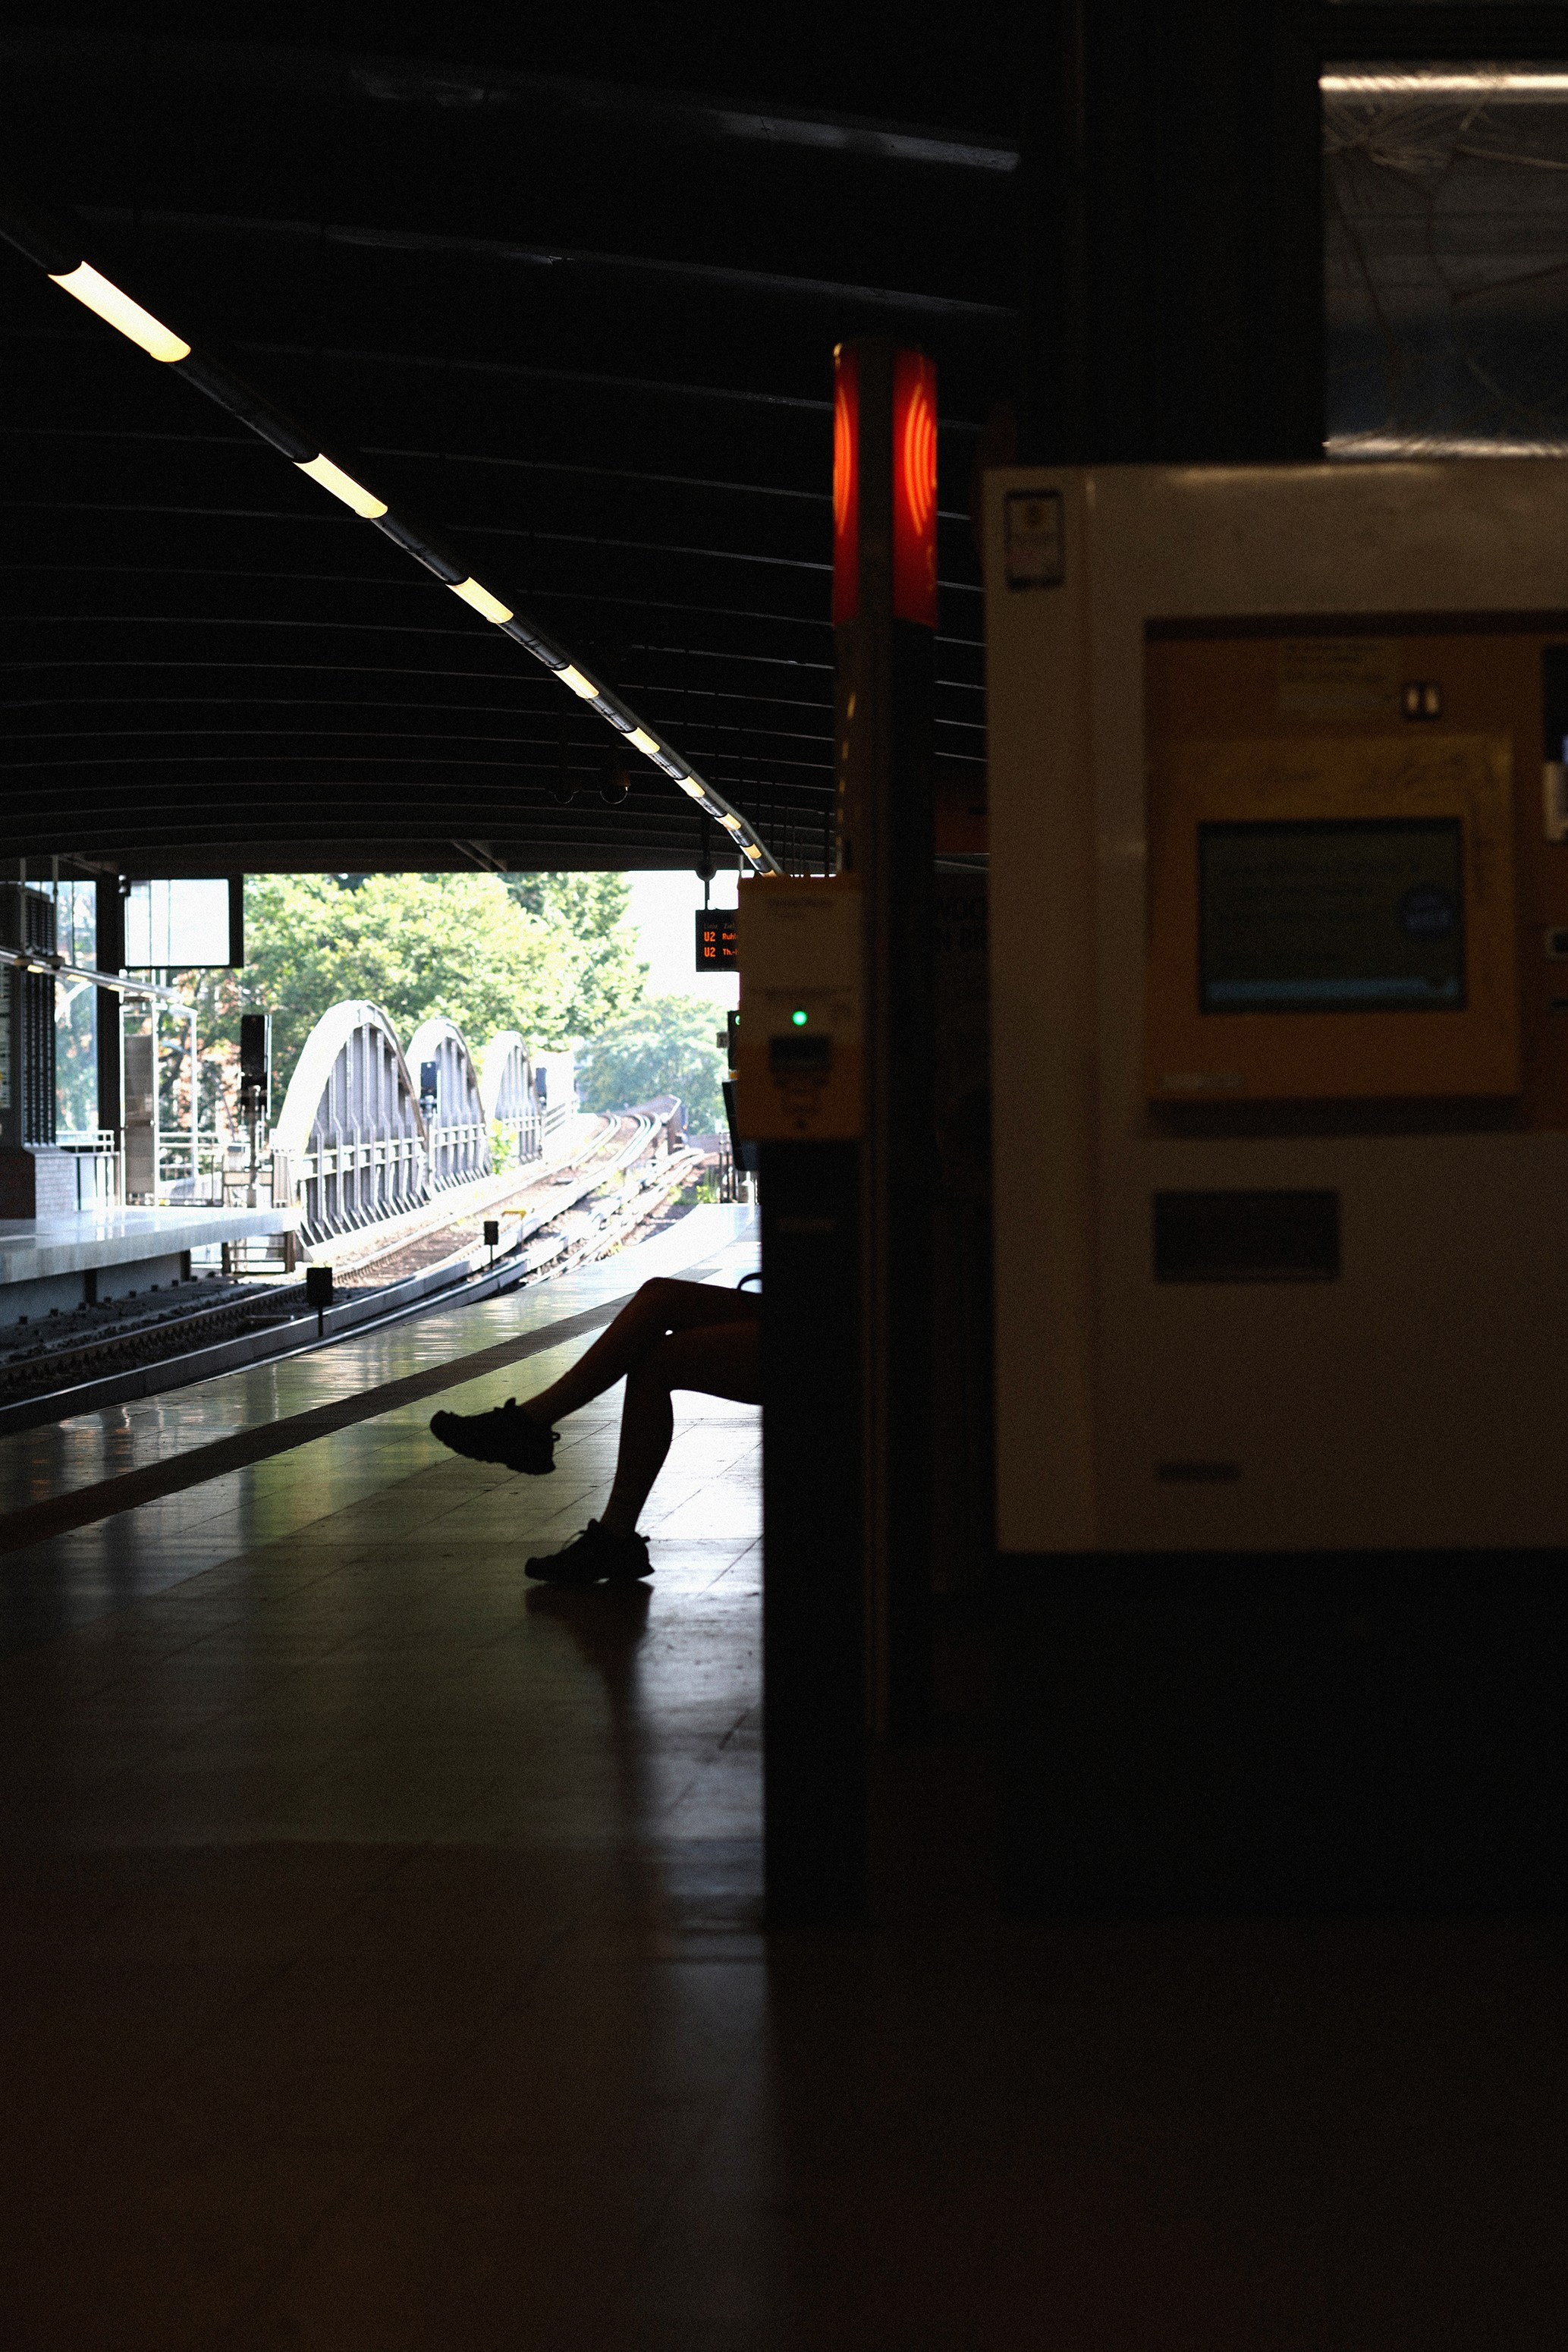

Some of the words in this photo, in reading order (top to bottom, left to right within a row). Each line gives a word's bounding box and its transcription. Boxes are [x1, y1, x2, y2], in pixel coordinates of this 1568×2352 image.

[703, 930, 716, 942] U2
[721, 932, 737, 940] Ruhl
[703, 945, 716, 957] U2
